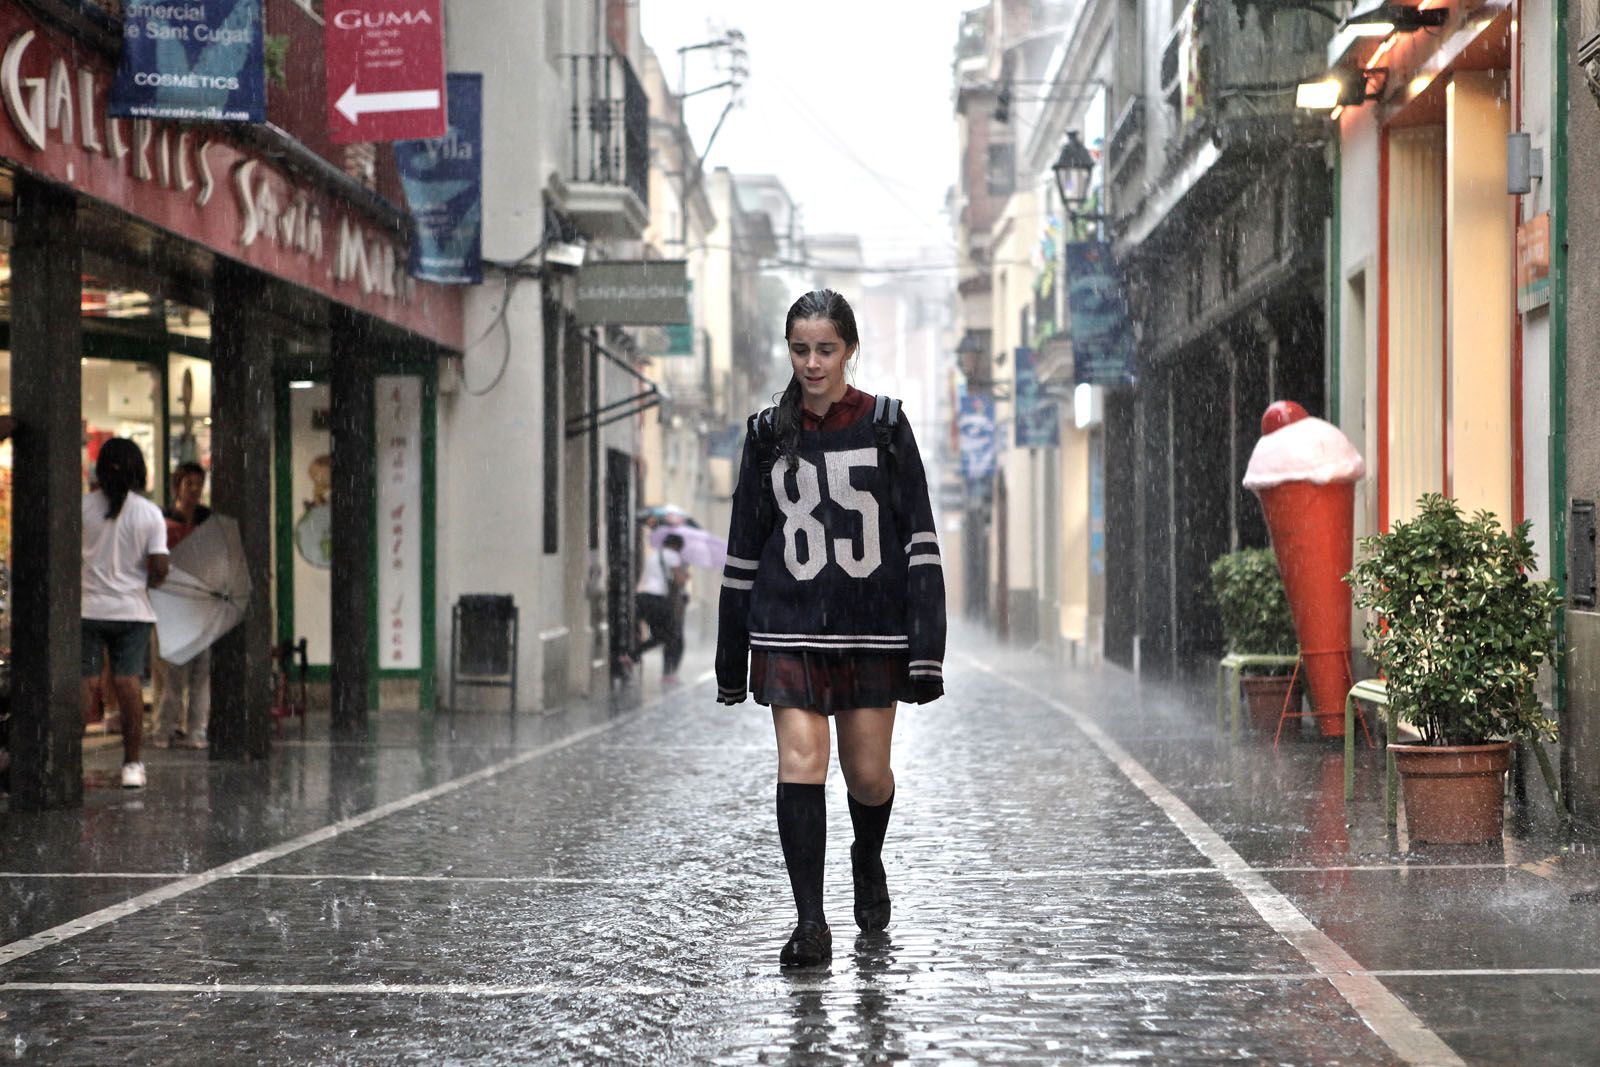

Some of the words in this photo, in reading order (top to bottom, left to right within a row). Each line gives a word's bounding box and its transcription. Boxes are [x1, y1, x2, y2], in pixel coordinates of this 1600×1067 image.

[126, 3, 205, 20] omercial
[334, 9, 433, 30] GUMA
[145, 22, 190, 40] Sant
[193, 23, 252, 46] Cugat
[425, 133, 473, 160] Vila
[770, 447, 882, 581] 85
